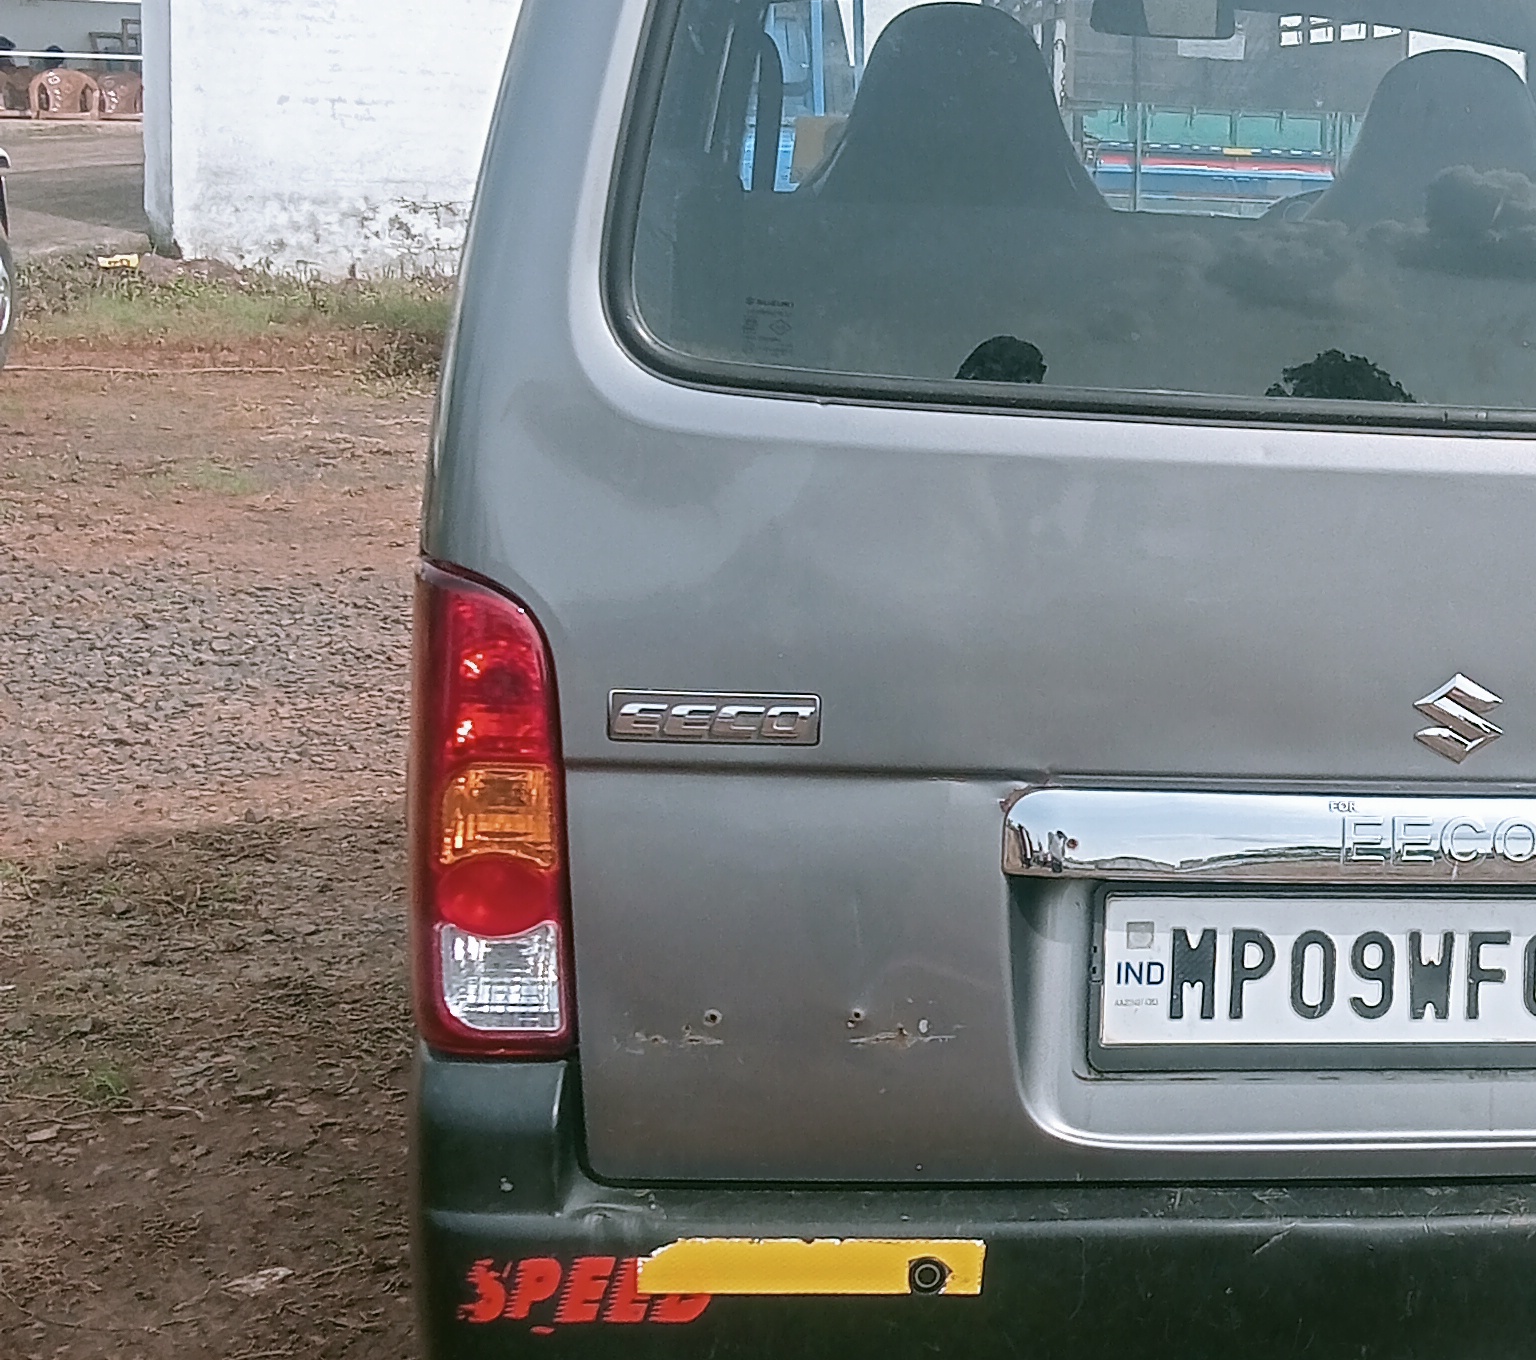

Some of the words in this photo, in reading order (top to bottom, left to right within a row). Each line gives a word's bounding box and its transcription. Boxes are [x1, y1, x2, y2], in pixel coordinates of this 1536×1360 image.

[613, 702, 817, 738] EECO
[1328, 800, 1357, 812] FOR
[1115, 961, 1165, 985] IND
